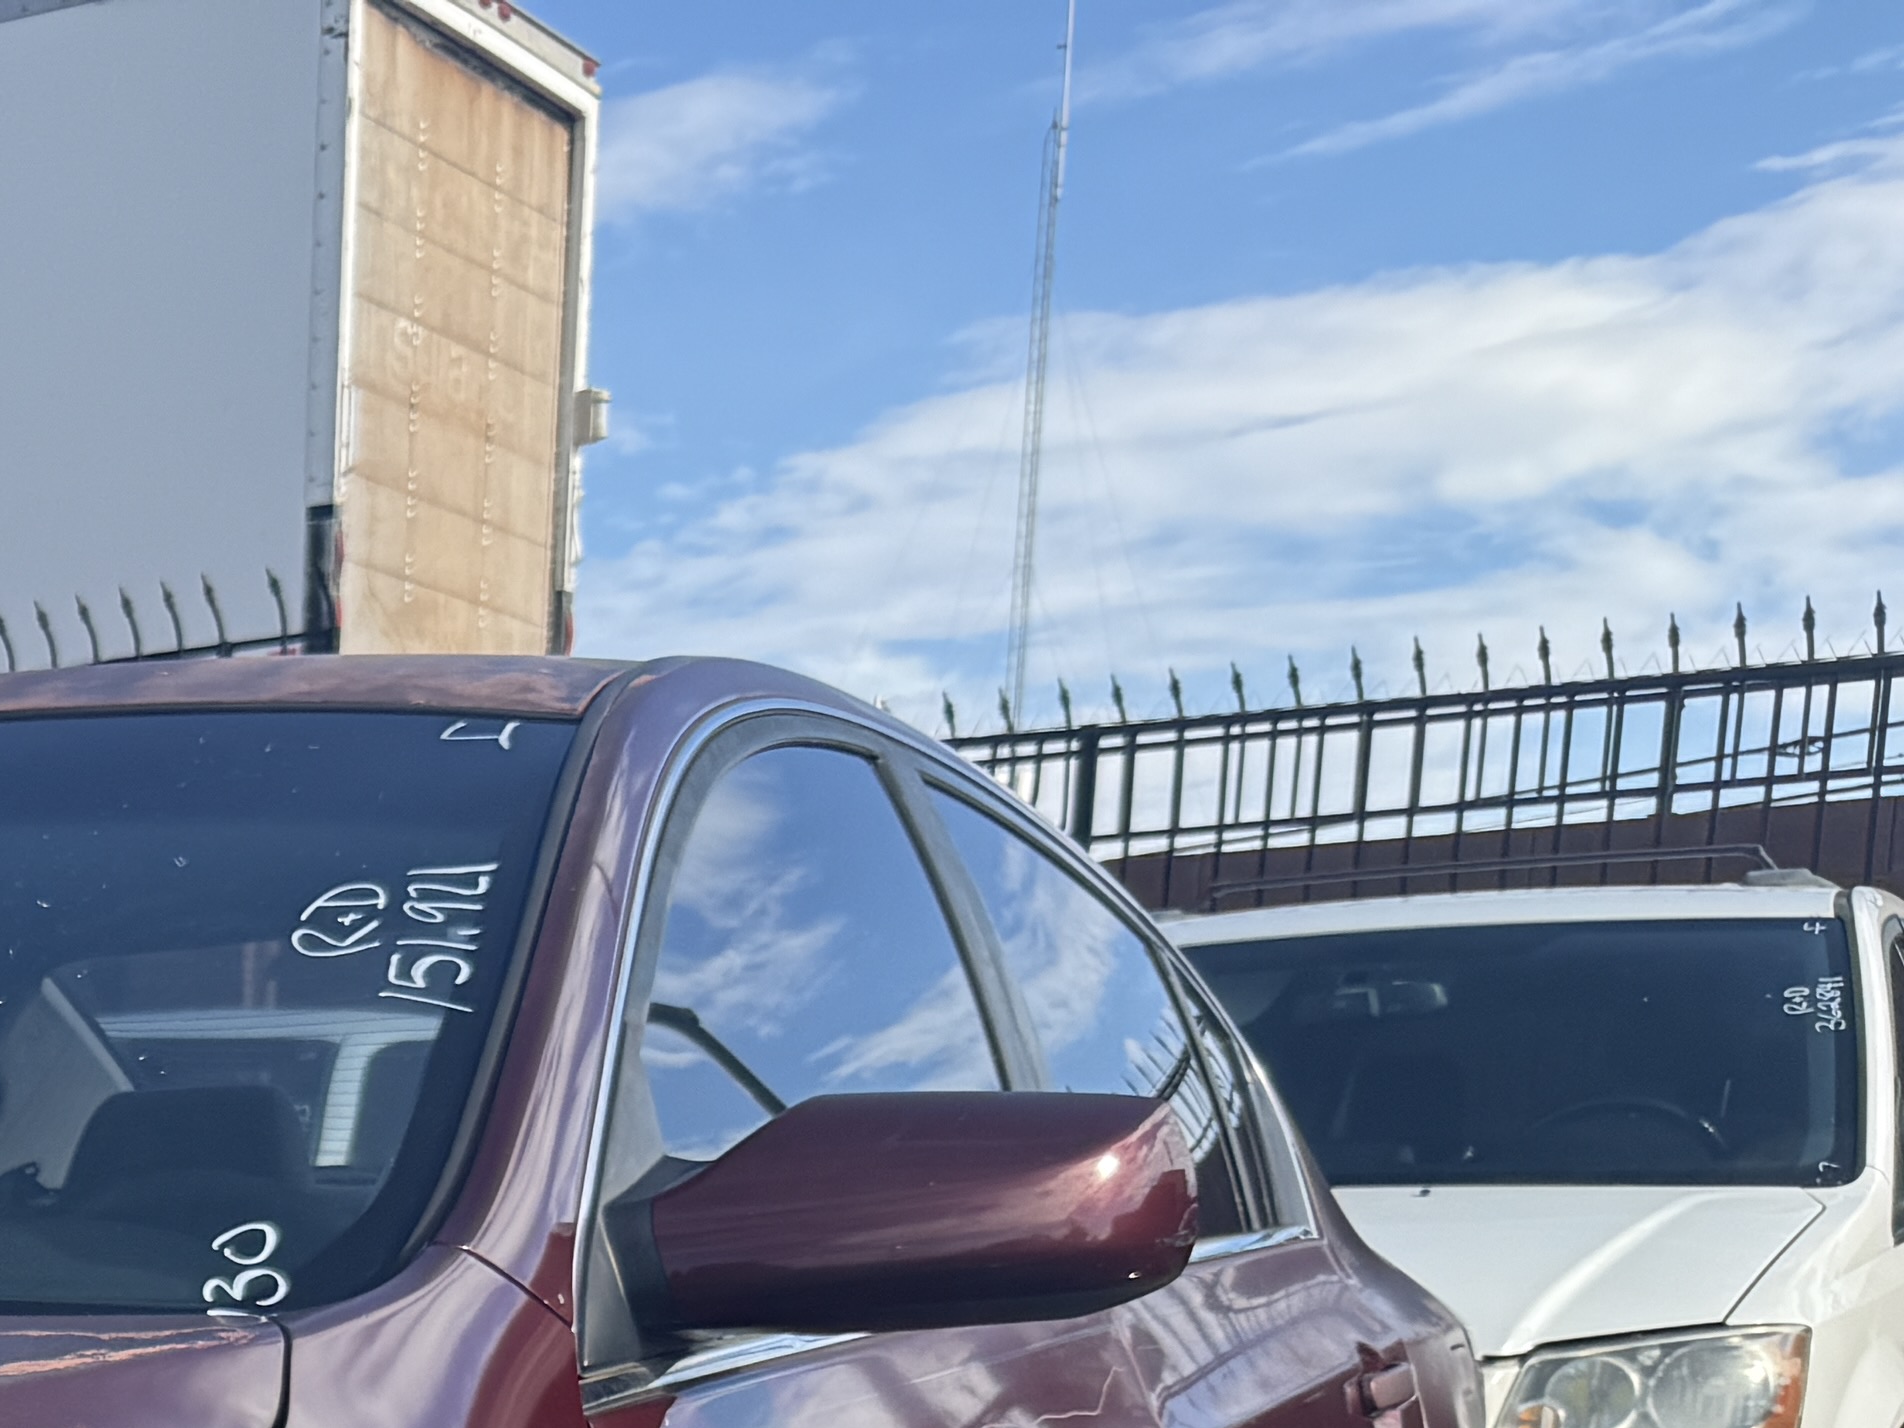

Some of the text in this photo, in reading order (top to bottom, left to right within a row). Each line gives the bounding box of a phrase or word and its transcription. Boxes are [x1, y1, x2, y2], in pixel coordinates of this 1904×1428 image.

[290, 884, 387, 957] R+D
[378, 861, 499, 1012] 151,921
[202, 1221, 290, 1324] 130
